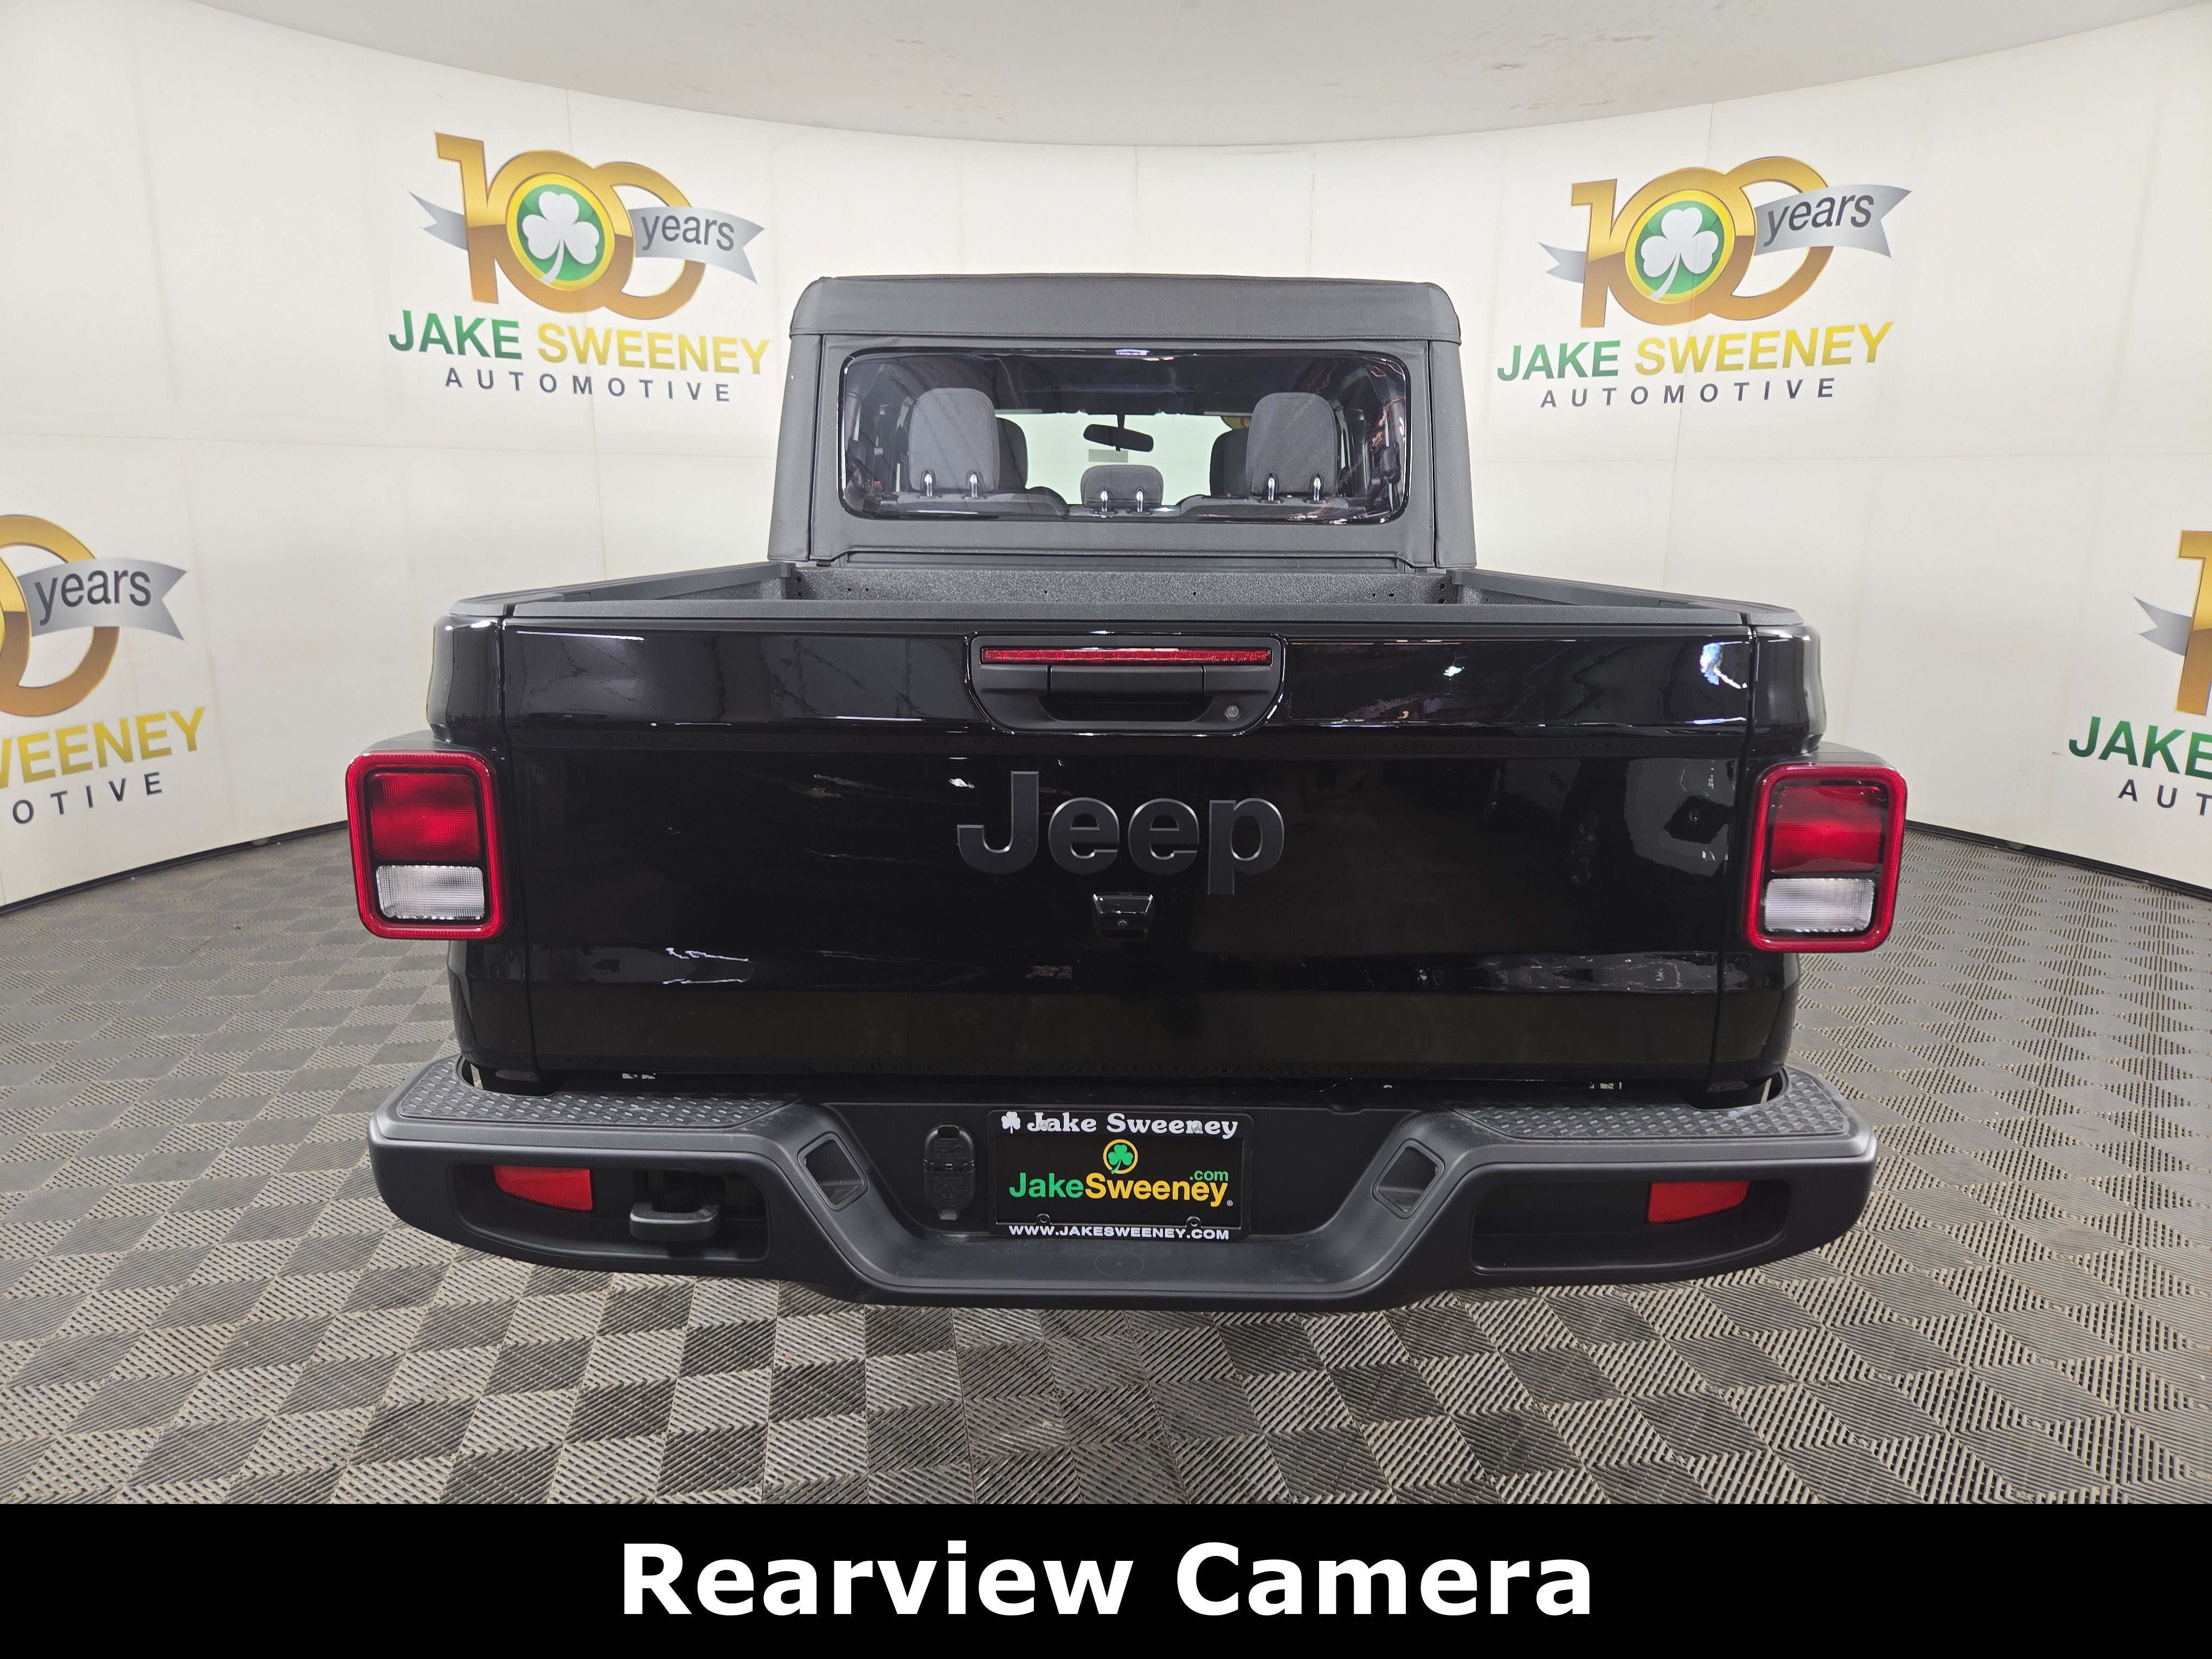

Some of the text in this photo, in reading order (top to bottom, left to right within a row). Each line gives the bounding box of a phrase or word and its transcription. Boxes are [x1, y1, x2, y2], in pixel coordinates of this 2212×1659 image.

[435, 132, 736, 320] 100 years
[1571, 156, 1874, 329] 100 years
[388, 310, 770, 375] JAKE SWEENEY
[1497, 321, 1895, 382] JAKE SWEENEY
[445, 367, 730, 402] AUTOMOTIVE
[1540, 377, 1835, 409] AUTOMOTIVE
[34, 569, 152, 626] years
[0, 706, 205, 789] EENEY
[2068, 716, 2212, 780] JAKE
[12, 771, 162, 825] OTIVE
[957, 770, 1284, 896] Jeep
[1027, 1111, 1238, 1140] Jake Sweeney
[1008, 1225, 1230, 1240] WWW.JAKESWEENEY.COM
